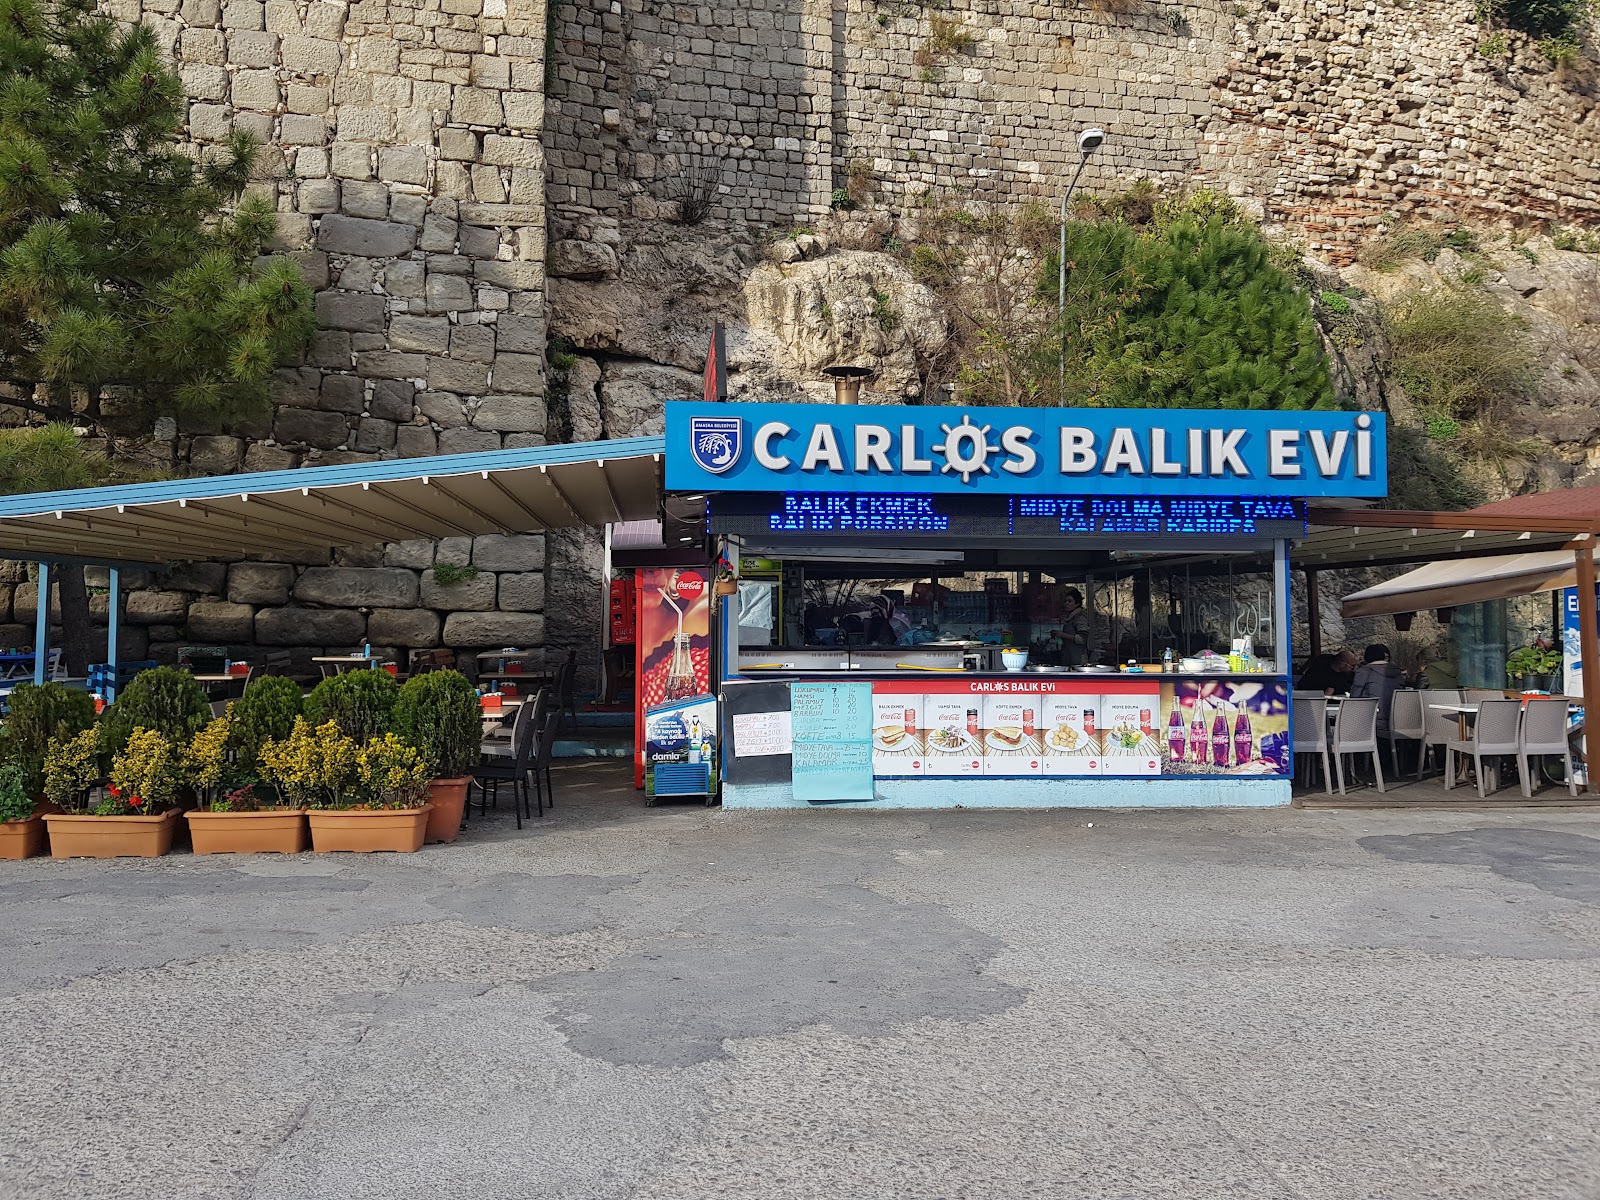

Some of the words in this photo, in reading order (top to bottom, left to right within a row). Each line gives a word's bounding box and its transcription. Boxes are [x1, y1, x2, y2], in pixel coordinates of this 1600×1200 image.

[753, 416, 1037, 482] CARLOS
[1059, 426, 1250, 475] BALIK
[1268, 414, 1371, 476] EVİ
[677, 581, 702, 589] Coca-Cola
[970, 682, 1009, 692] CARLOS
[1011, 682, 1038, 691] BALIK
[652, 752, 680, 760] damla
